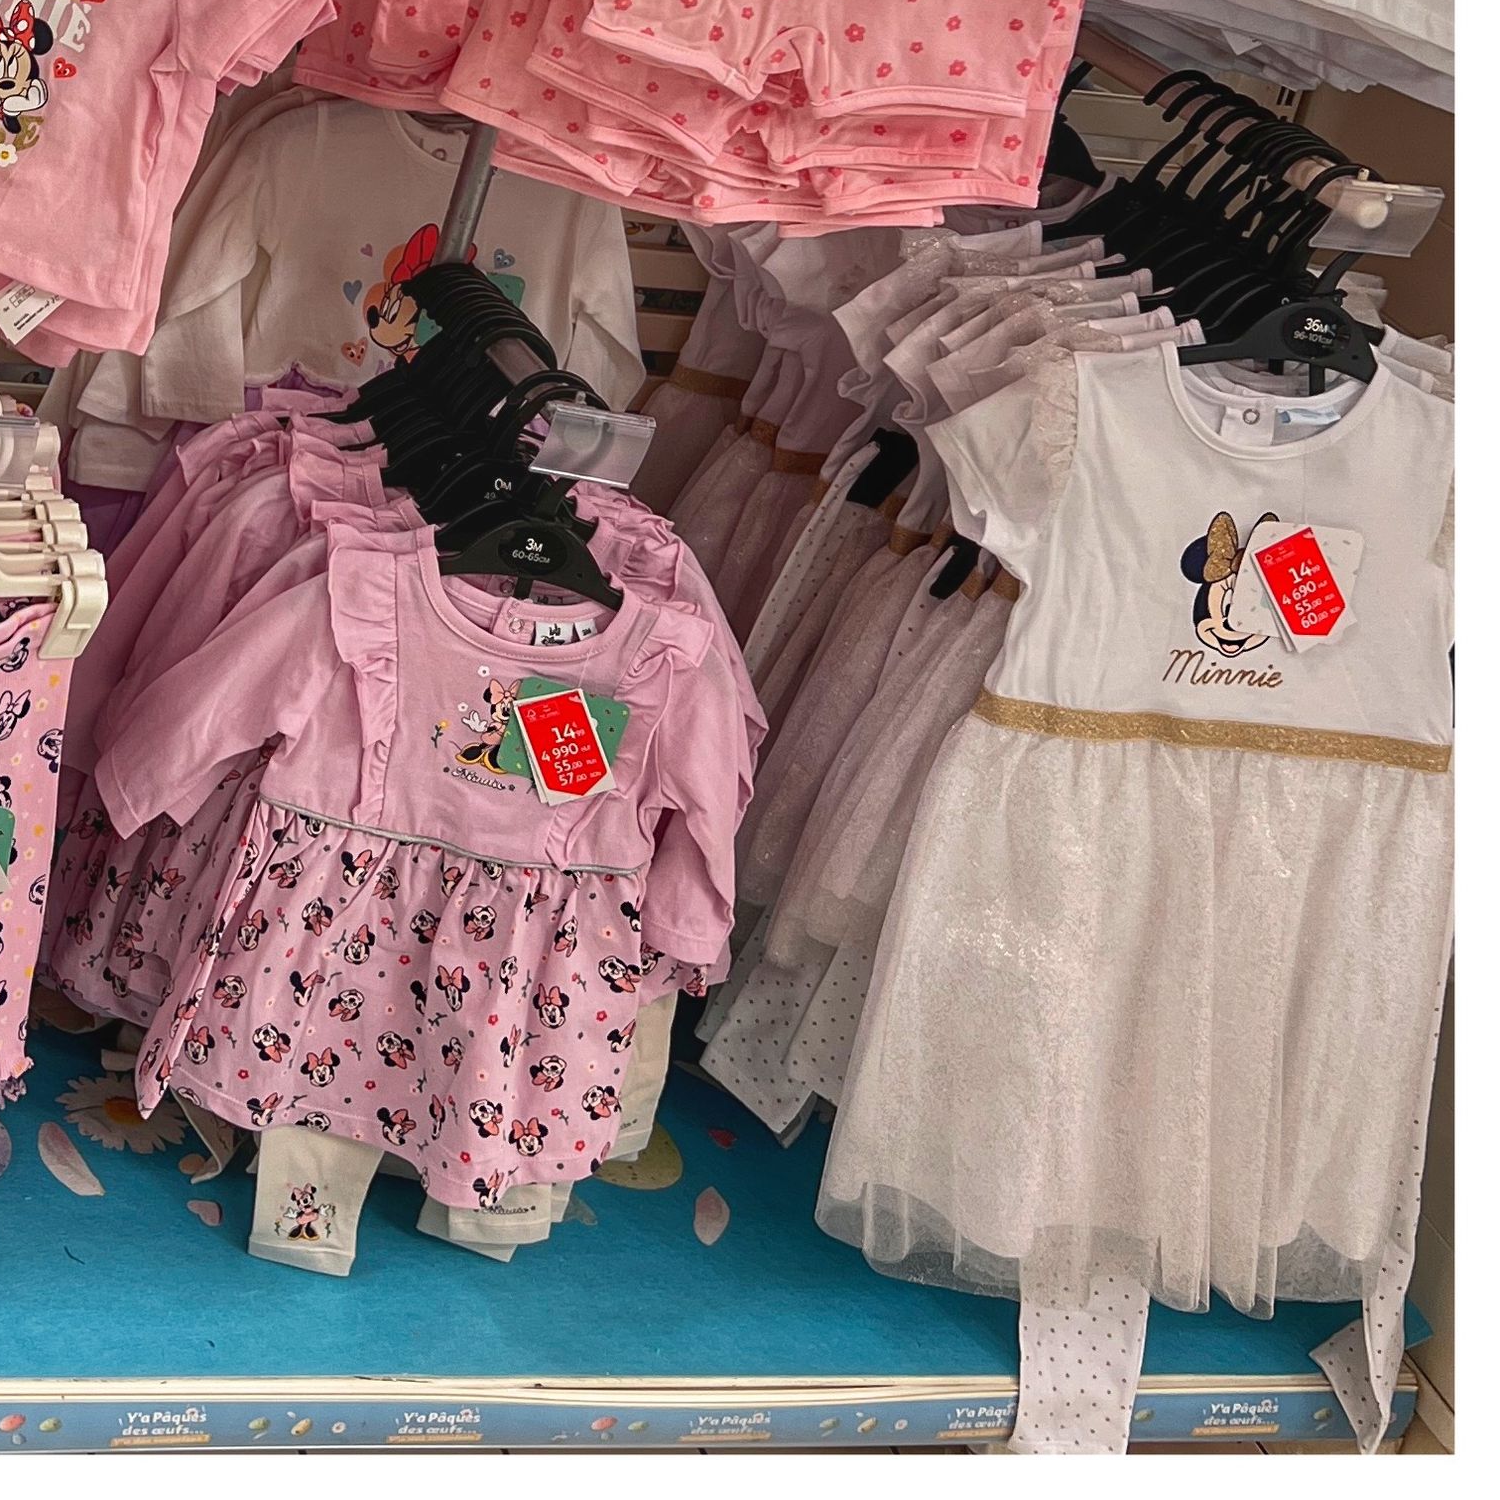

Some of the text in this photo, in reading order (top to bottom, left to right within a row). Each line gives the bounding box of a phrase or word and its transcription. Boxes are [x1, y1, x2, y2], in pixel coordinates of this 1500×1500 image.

[1303, 317, 1329, 333] 36M
[525, 538, 543, 553] 3M
[512, 549, 551, 564] 60-65CM
[1162, 649, 1284, 689] Minnie
[977, 1406, 1010, 1420] Pâqu
[1210, 1404, 1231, 1414] Y'a
[127, 1411, 208, 1425] Y'a Pâques
[403, 1411, 481, 1425] Y'a Pâques
[122, 1426, 148, 1436] des
[397, 1425, 423, 1435] des
